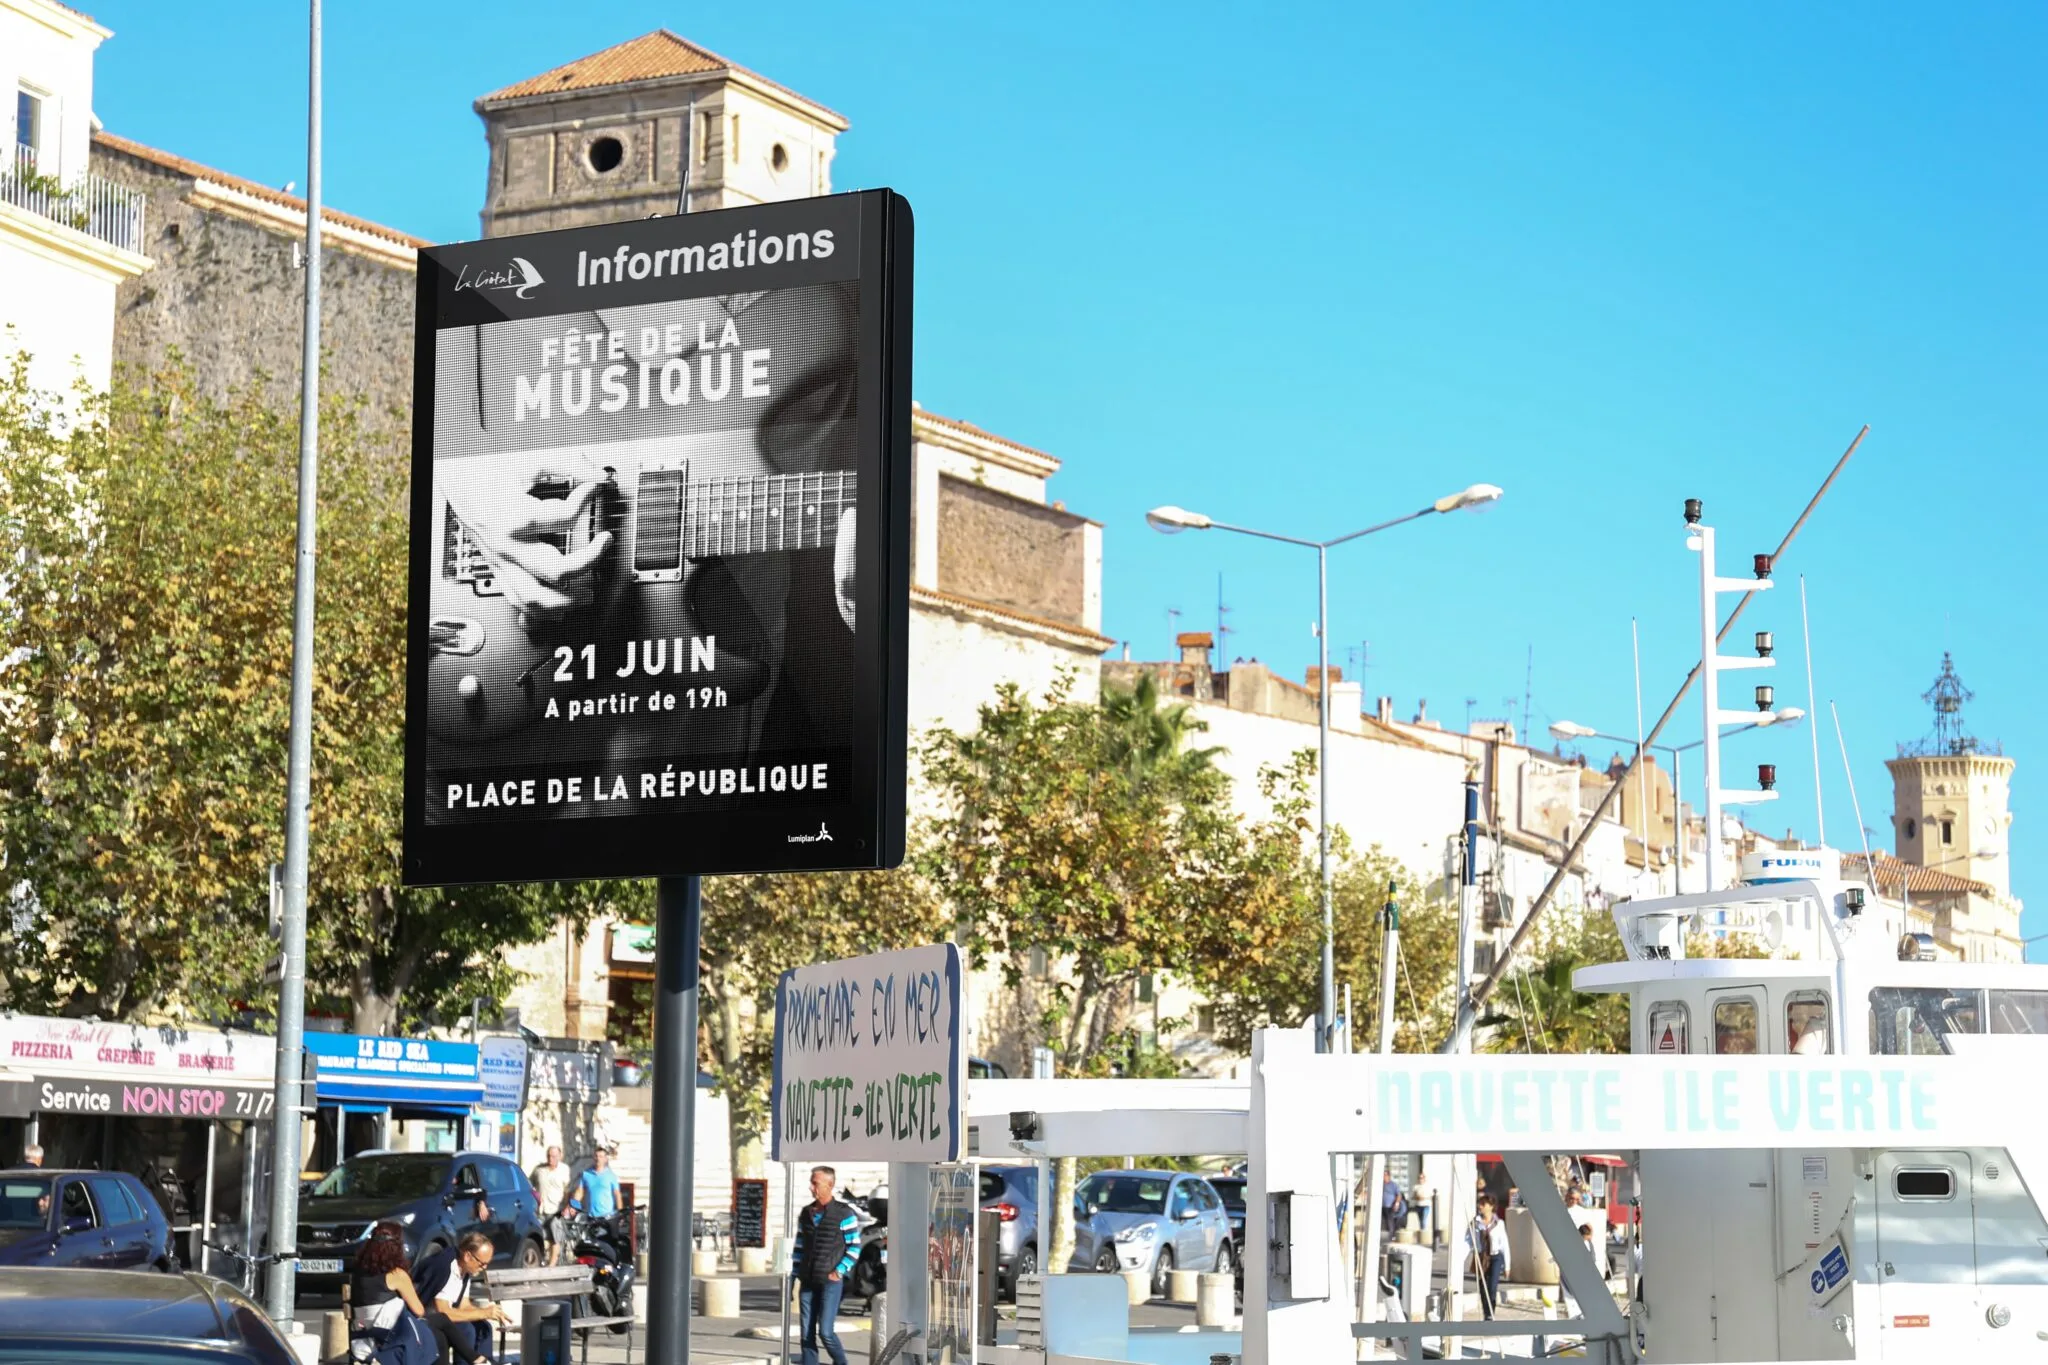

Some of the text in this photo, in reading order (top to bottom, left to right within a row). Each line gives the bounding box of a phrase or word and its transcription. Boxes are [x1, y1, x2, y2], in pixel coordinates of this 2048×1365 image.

[577, 229, 835, 287] Informations
[542, 317, 740, 367] FÊTE DE LA
[514, 348, 772, 422] MUSIQUE
[553, 635, 716, 682] 21 JUIN
[545, 686, 727, 722] A partir de 19h
[447, 763, 828, 809] PLACE DE LA RÉPUBLIQUE
[788, 834, 815, 844] Lumiplan
[788, 970, 941, 1056] PROMENADE EN MER
[12, 1041, 236, 1072] PIZZERIA CREPERIE BRASSERIE
[41, 1082, 111, 1112] Service
[123, 1085, 175, 1114] NON
[180, 1088, 226, 1116] STOP
[785, 1076, 854, 1144] NAVETTE
[886, 1071, 942, 1144] VERTE
[1377, 1069, 1937, 1133] NAVETTE ILE VERTE
